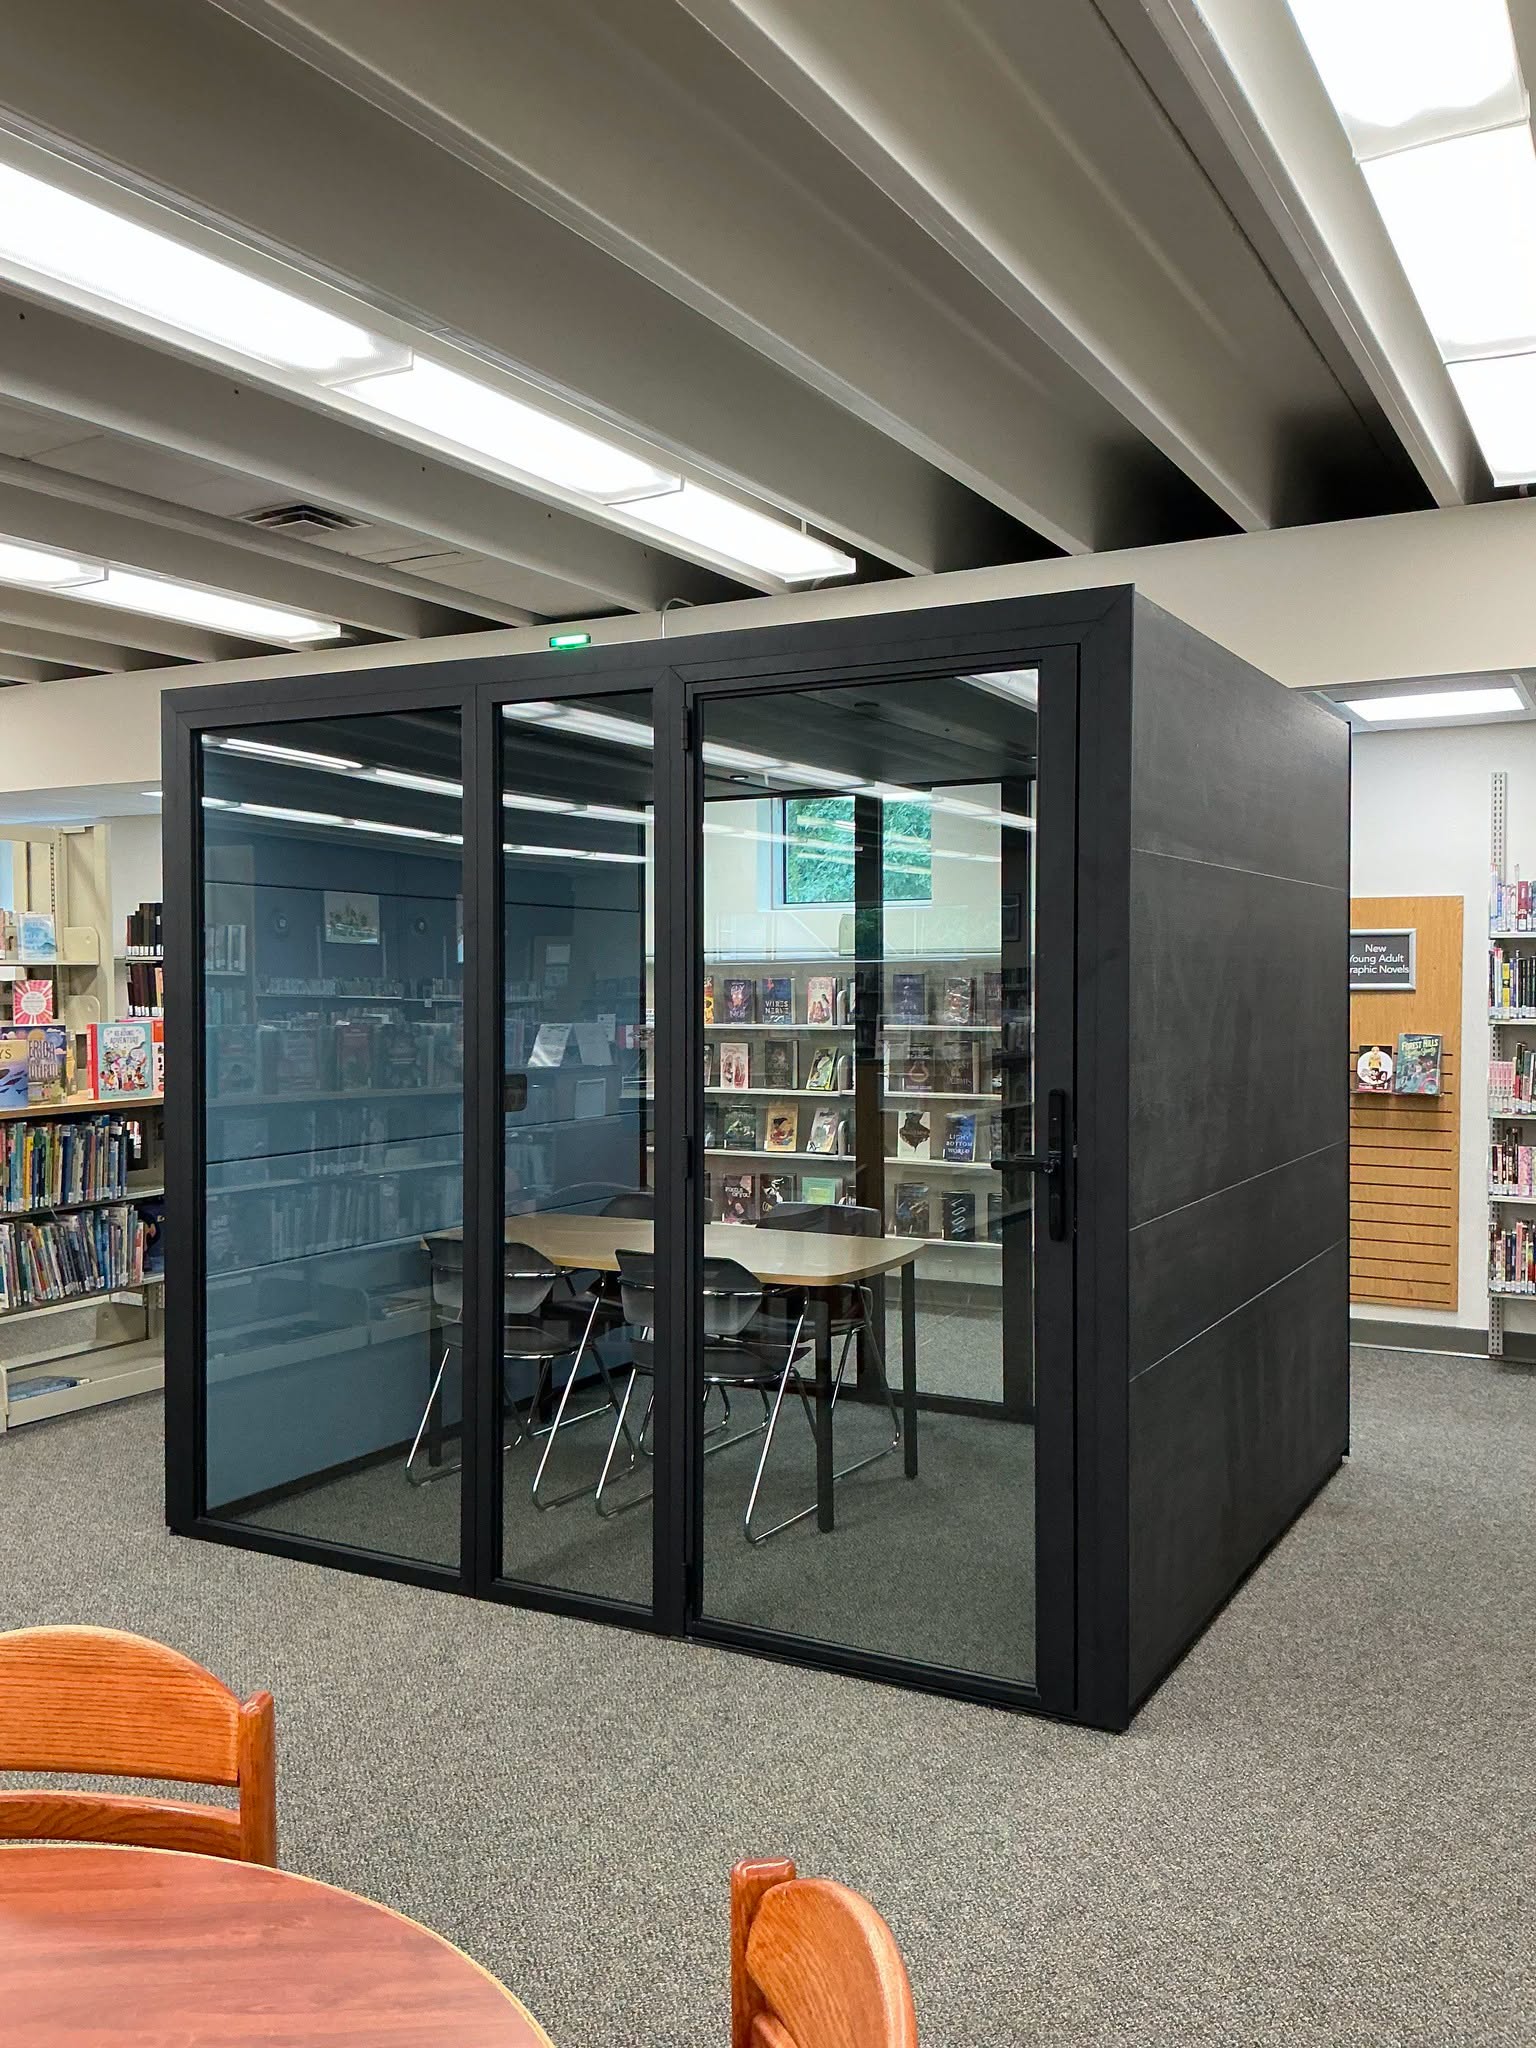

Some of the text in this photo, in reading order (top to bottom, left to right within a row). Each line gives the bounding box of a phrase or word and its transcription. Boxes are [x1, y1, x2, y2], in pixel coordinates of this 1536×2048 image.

[1365, 944, 1387, 953] New
[1379, 953, 1404, 963] Adult
[1350, 965, 1410, 976] raphic Novels
